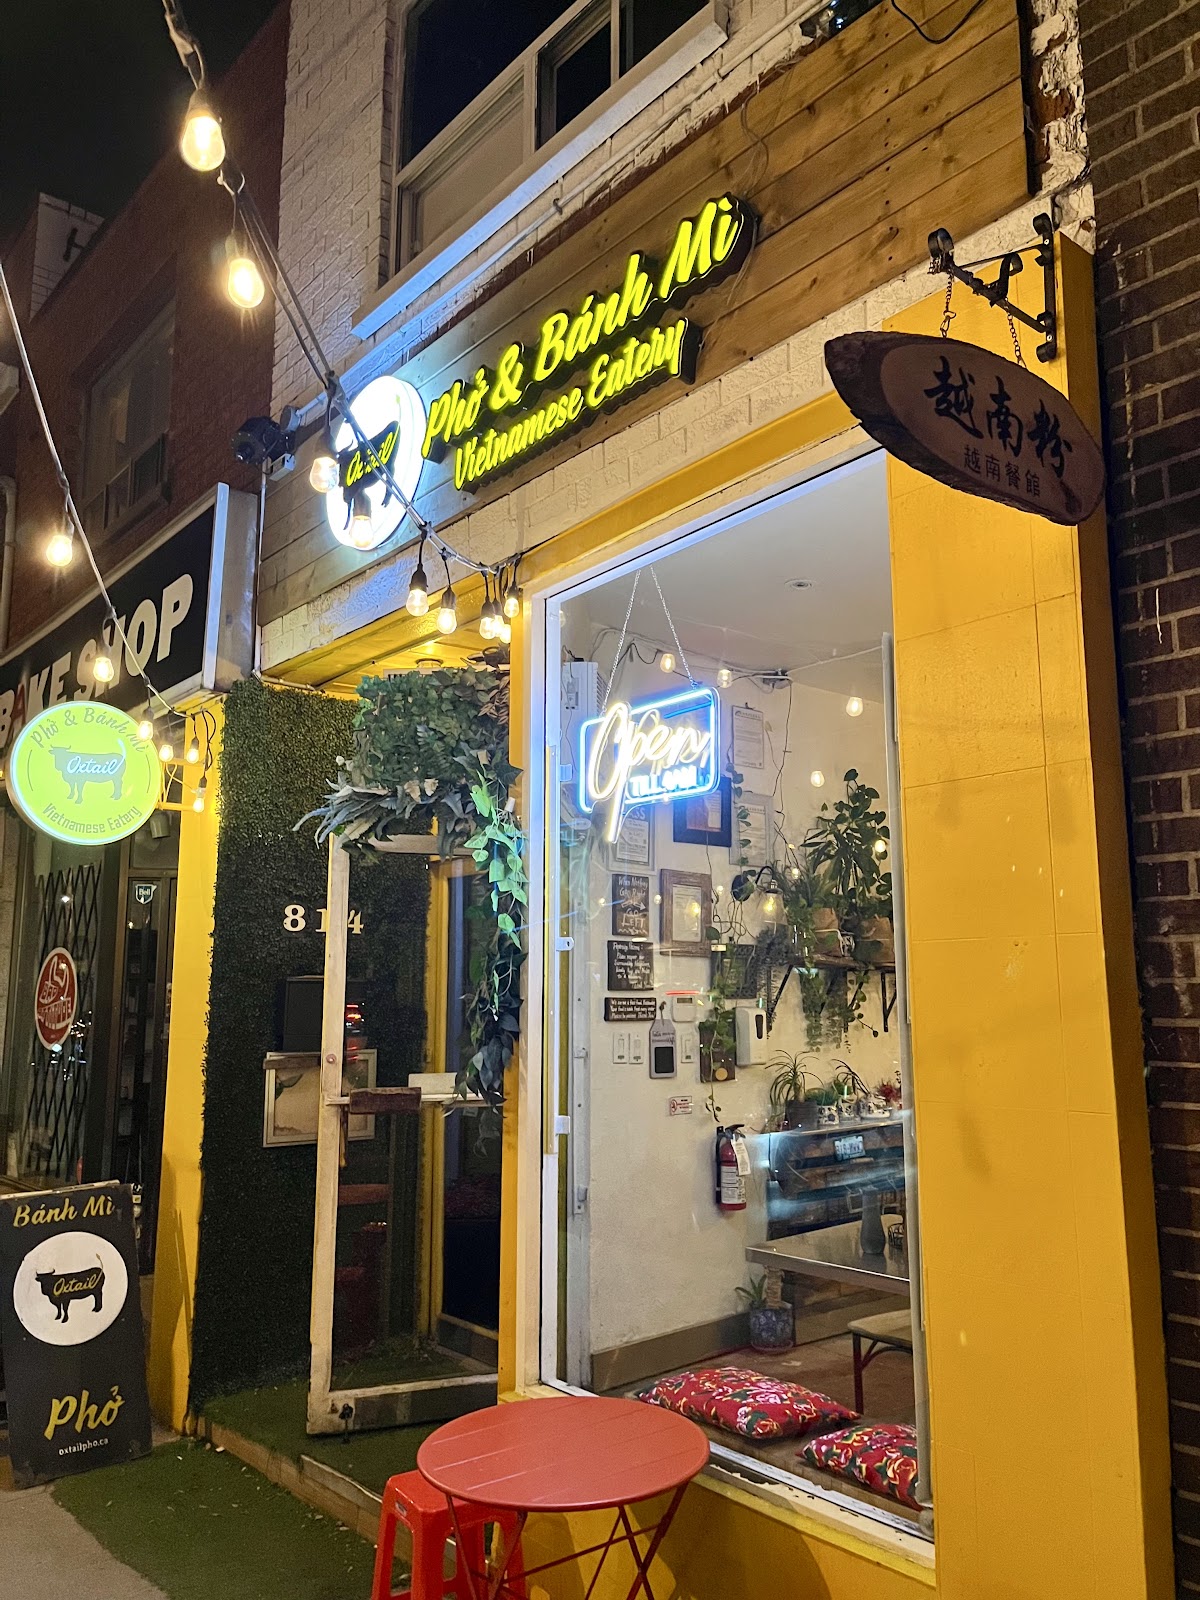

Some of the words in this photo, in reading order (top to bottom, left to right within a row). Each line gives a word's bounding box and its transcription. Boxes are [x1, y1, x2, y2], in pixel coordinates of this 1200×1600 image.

[422, 368, 491, 459] Phở
[490, 341, 524, 411] &
[533, 253, 654, 383] Bánh
[454, 388, 585, 491] Vietnamese
[587, 318, 687, 409] Eatery
[962, 445, 1041, 497] 越南餐館
[74, 574, 193, 701] SHOP
[64, 709, 78, 727] &
[83, 707, 130, 734] Bánh
[66, 755, 123, 775] Oxtail
[588, 702, 712, 844] Open
[42, 803, 106, 834] Vietnamese
[108, 806, 142, 831] Eatery
[139, 888, 151, 896] Bell
[621, 913, 646, 929] LEFT
[13, 1197, 77, 1227] Bánh
[82, 1195, 113, 1219] Mì
[53, 1275, 101, 1297] Oxtail
[44, 1386, 125, 1440] Phở
[58, 1438, 109, 1456] oxtailpho.ca
